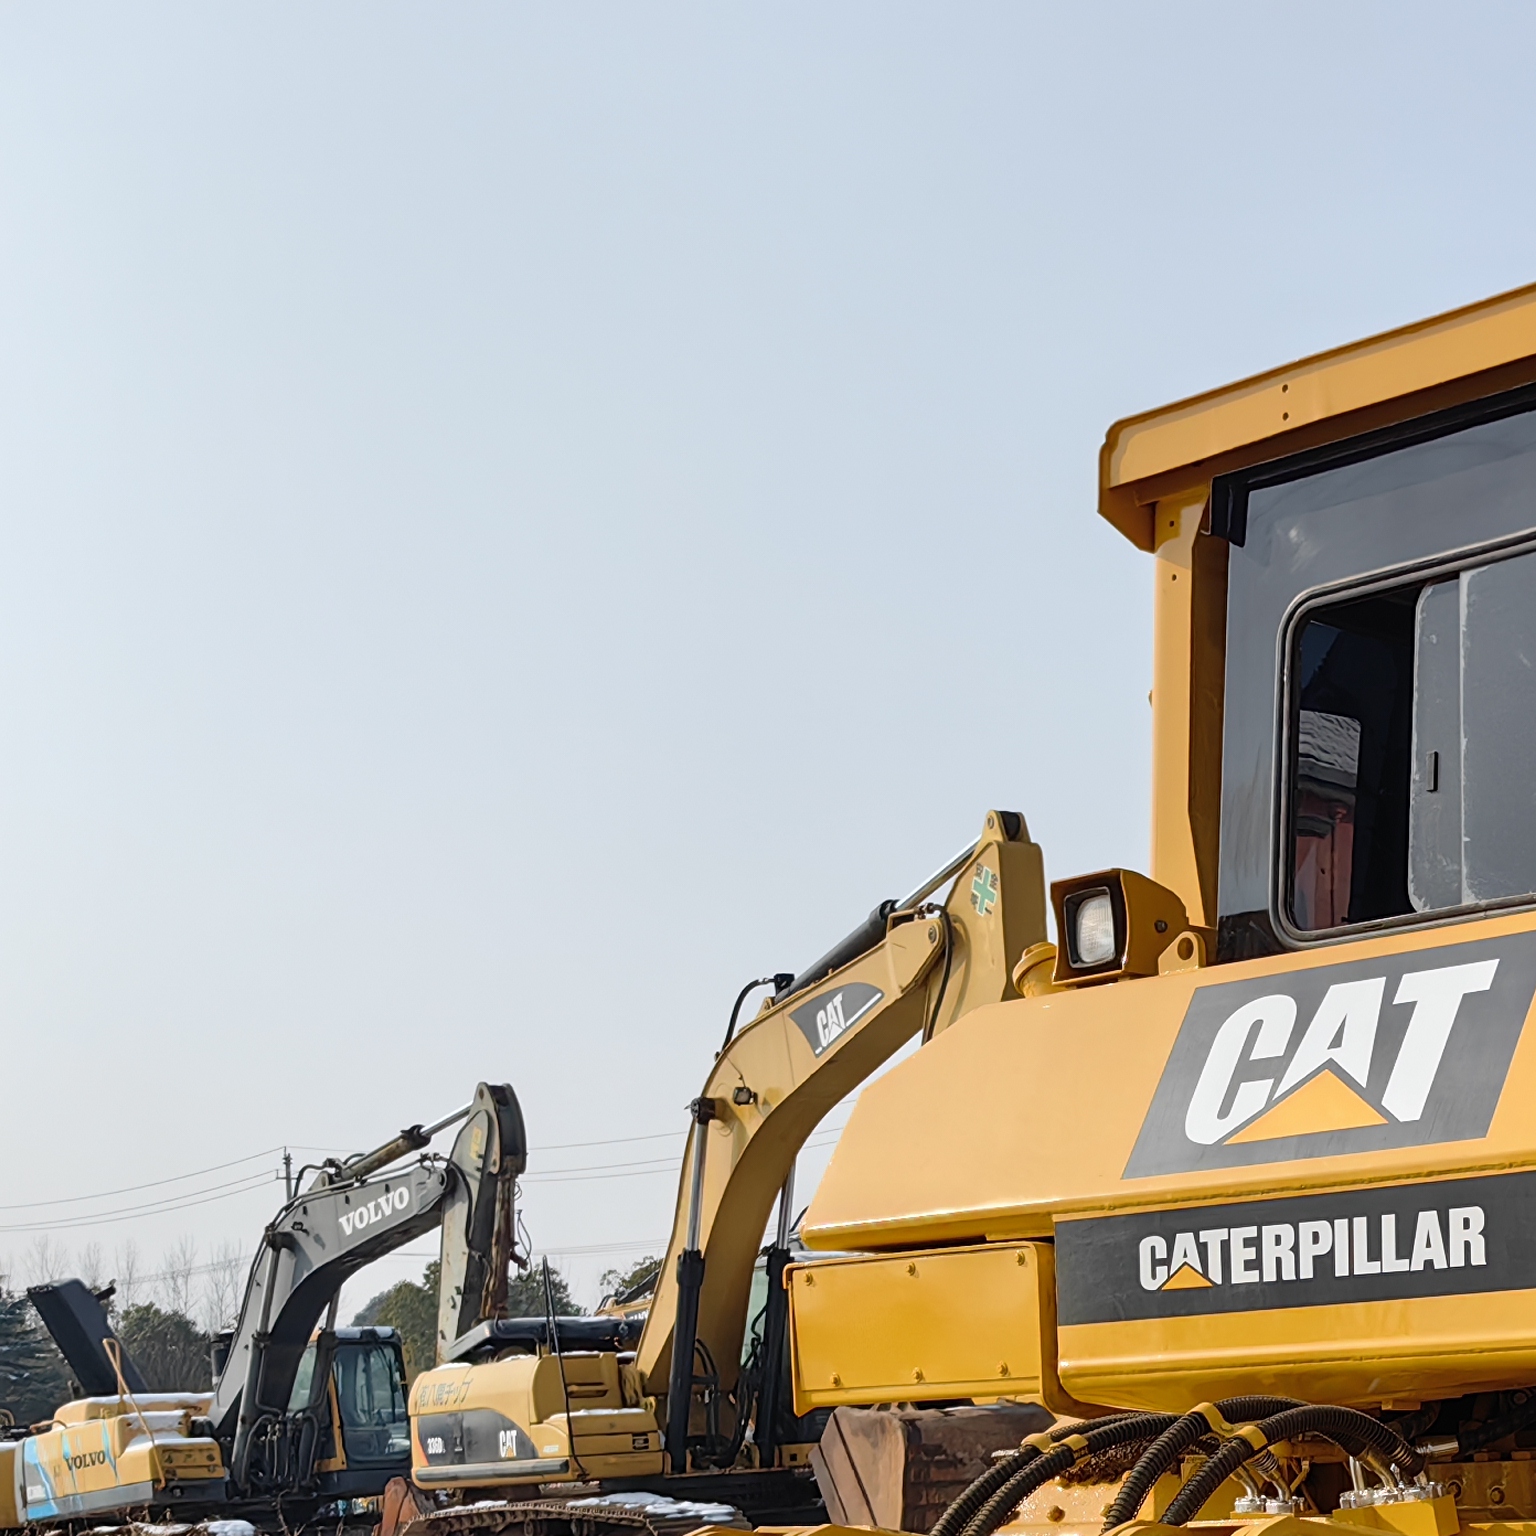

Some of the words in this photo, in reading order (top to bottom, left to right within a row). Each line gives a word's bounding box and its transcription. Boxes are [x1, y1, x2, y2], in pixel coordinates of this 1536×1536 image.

[817, 991, 845, 1047] CAT
[1184, 958, 1499, 1145] CAT
[338, 1186, 409, 1235] VOLVO
[1139, 1206, 1486, 1290] CATERPILLAR
[66, 1450, 105, 1470] VOLVO
[499, 1430, 517, 1457] CAT
